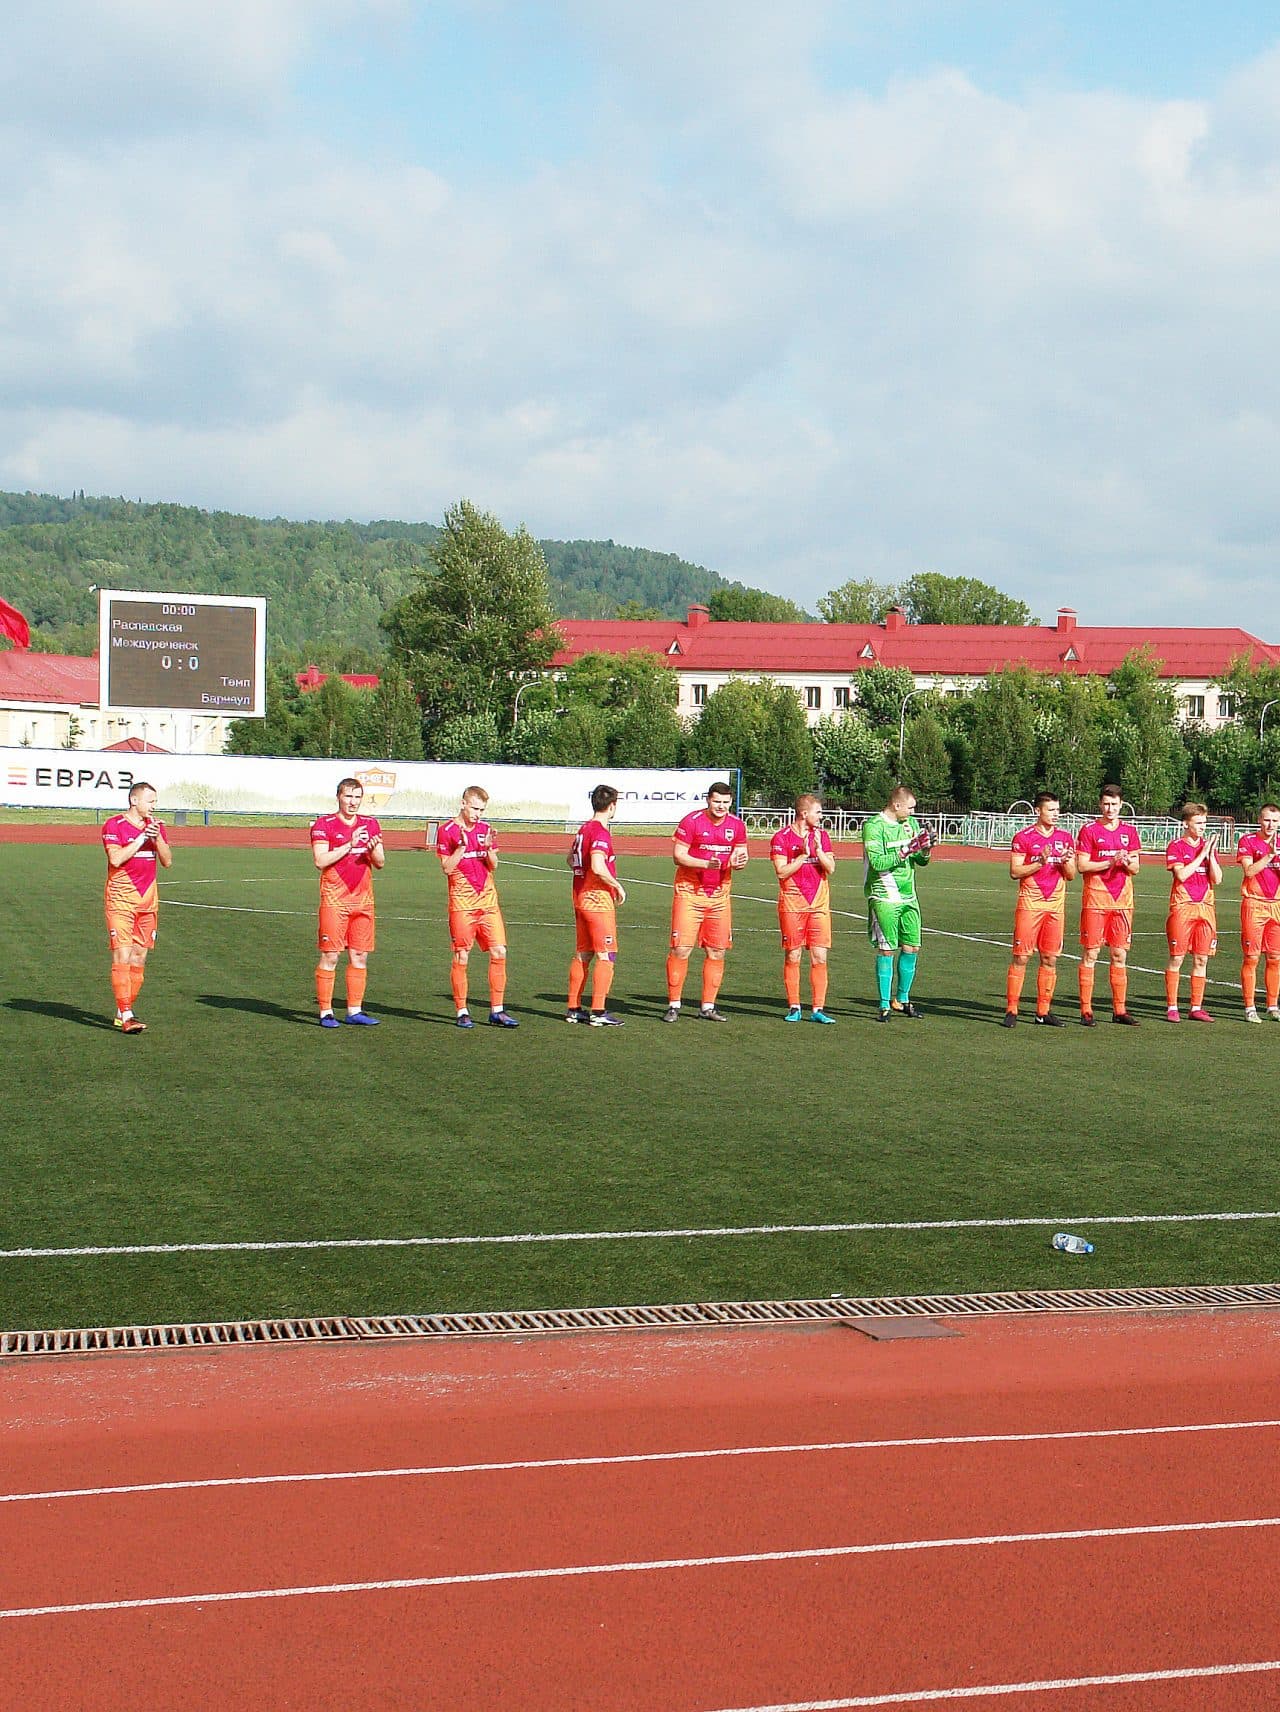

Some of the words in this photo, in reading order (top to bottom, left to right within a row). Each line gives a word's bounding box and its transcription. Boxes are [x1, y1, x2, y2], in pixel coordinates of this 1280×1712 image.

[162, 604, 196, 616] 00:00
[112, 619, 183, 633] Распадская
[112, 637, 199, 650] Междуреченск
[161, 655, 172, 670] 0
[189, 656, 199, 670] 0
[220, 676, 250, 687] Темп
[201, 693, 250, 705] Барнаул
[35, 768, 134, 789] ЕВРАЗ
